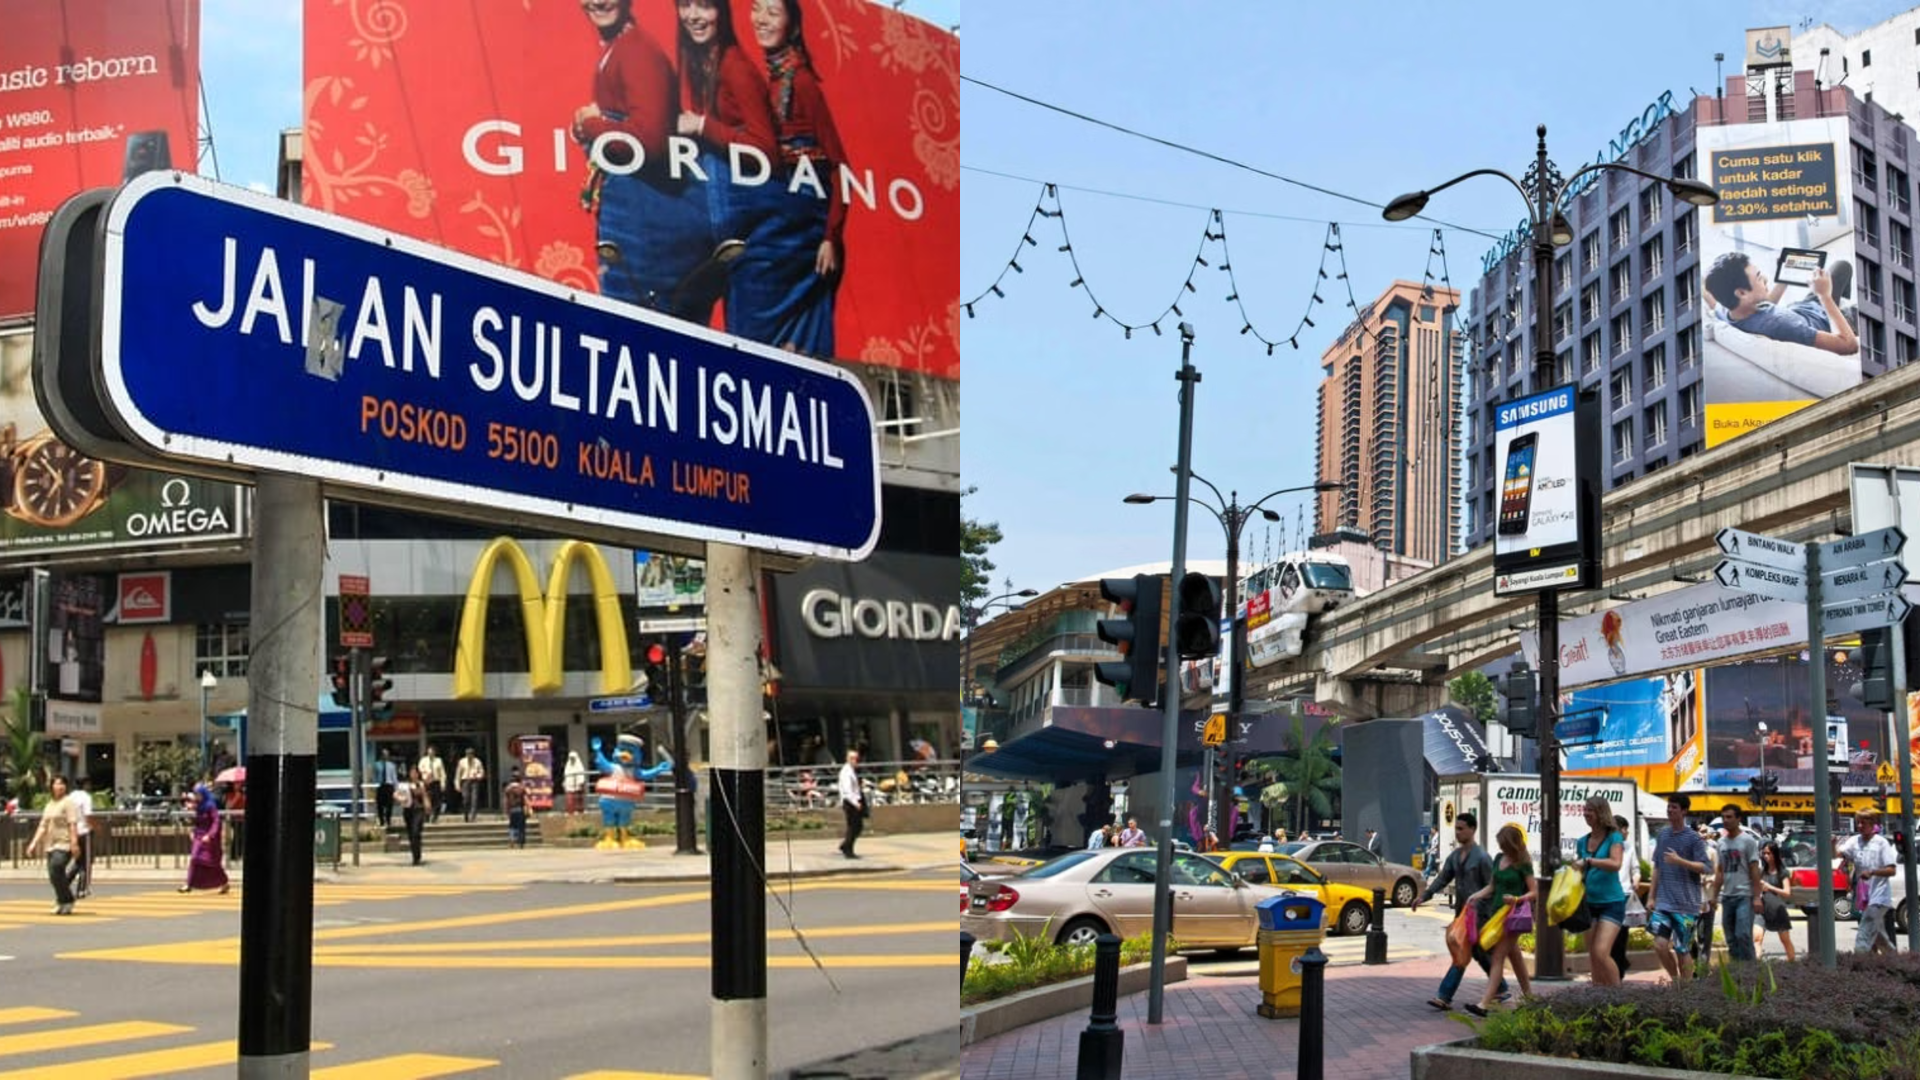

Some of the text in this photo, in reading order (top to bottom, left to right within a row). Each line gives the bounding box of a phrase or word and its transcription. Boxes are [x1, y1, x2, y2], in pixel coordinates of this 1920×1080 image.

[55, 55, 158, 85] reborn
[1718, 150, 1822, 168] Cuma satu klik
[461, 119, 924, 221] GIORDANO
[1719, 169, 1803, 184] untuk kadar
[1719, 182, 1827, 200] faedah setinggi
[1772, 200, 1833, 213] setahun.
[469, 306, 678, 432] SULTAN
[698, 367, 844, 470] ISMAIL
[1501, 394, 1568, 424] SAMSUNG
[1713, 419, 1740, 429] Buka
[360, 394, 750, 504] POSKOD 55100 KUALA LUMPUR
[127, 506, 229, 537] OMEGA
[1532, 515, 1561, 527] GALAXY
[1747, 536, 1796, 555] BINTANG WALK
[1745, 566, 1800, 587] KOMPLEKS KRAF
[1833, 573, 1860, 586] MENARA
[1650, 608, 1682, 628] Nikmati
[1681, 601, 1720, 624] ganjaran
[1718, 592, 1759, 611] lumayan
[1825, 604, 1853, 620] PETRONAS
[1655, 621, 1709, 644] Great Eastern
[1560, 637, 1589, 668] Great!
[1195, 720, 1253, 734] SY
[1501, 802, 1519, 815] Tel:
